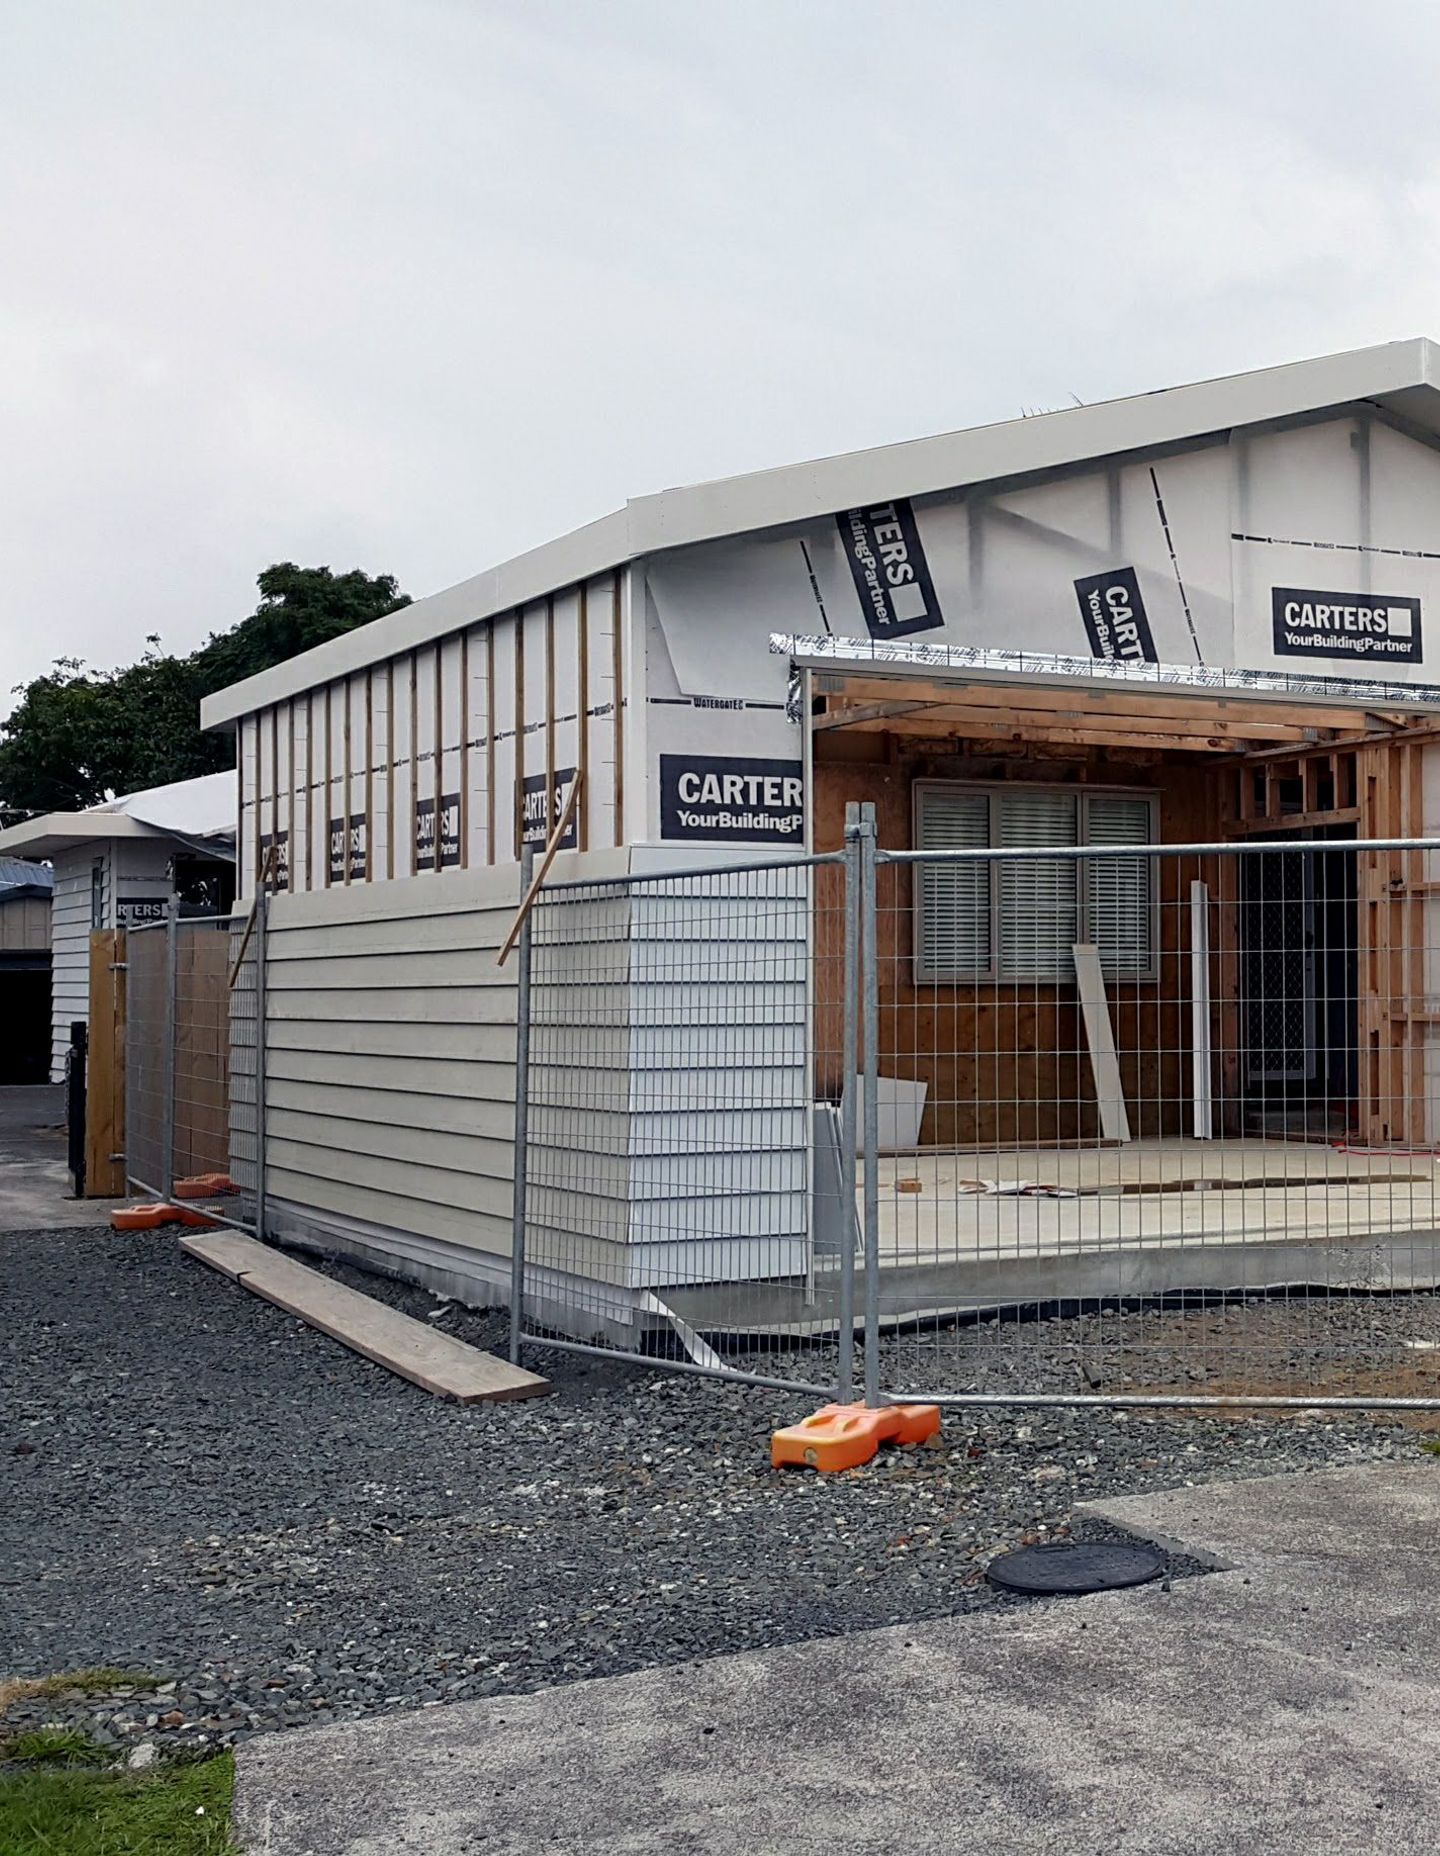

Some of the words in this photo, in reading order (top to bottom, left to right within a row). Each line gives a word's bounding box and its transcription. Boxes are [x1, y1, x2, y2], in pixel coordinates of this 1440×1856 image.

[870, 503, 914, 585] TERS
[1284, 602, 1388, 633] CARTERS
[1284, 631, 1413, 654] YourBuildingPartner
[678, 772, 803, 807] CARTER
[676, 810, 803, 833] YourBuildingP
